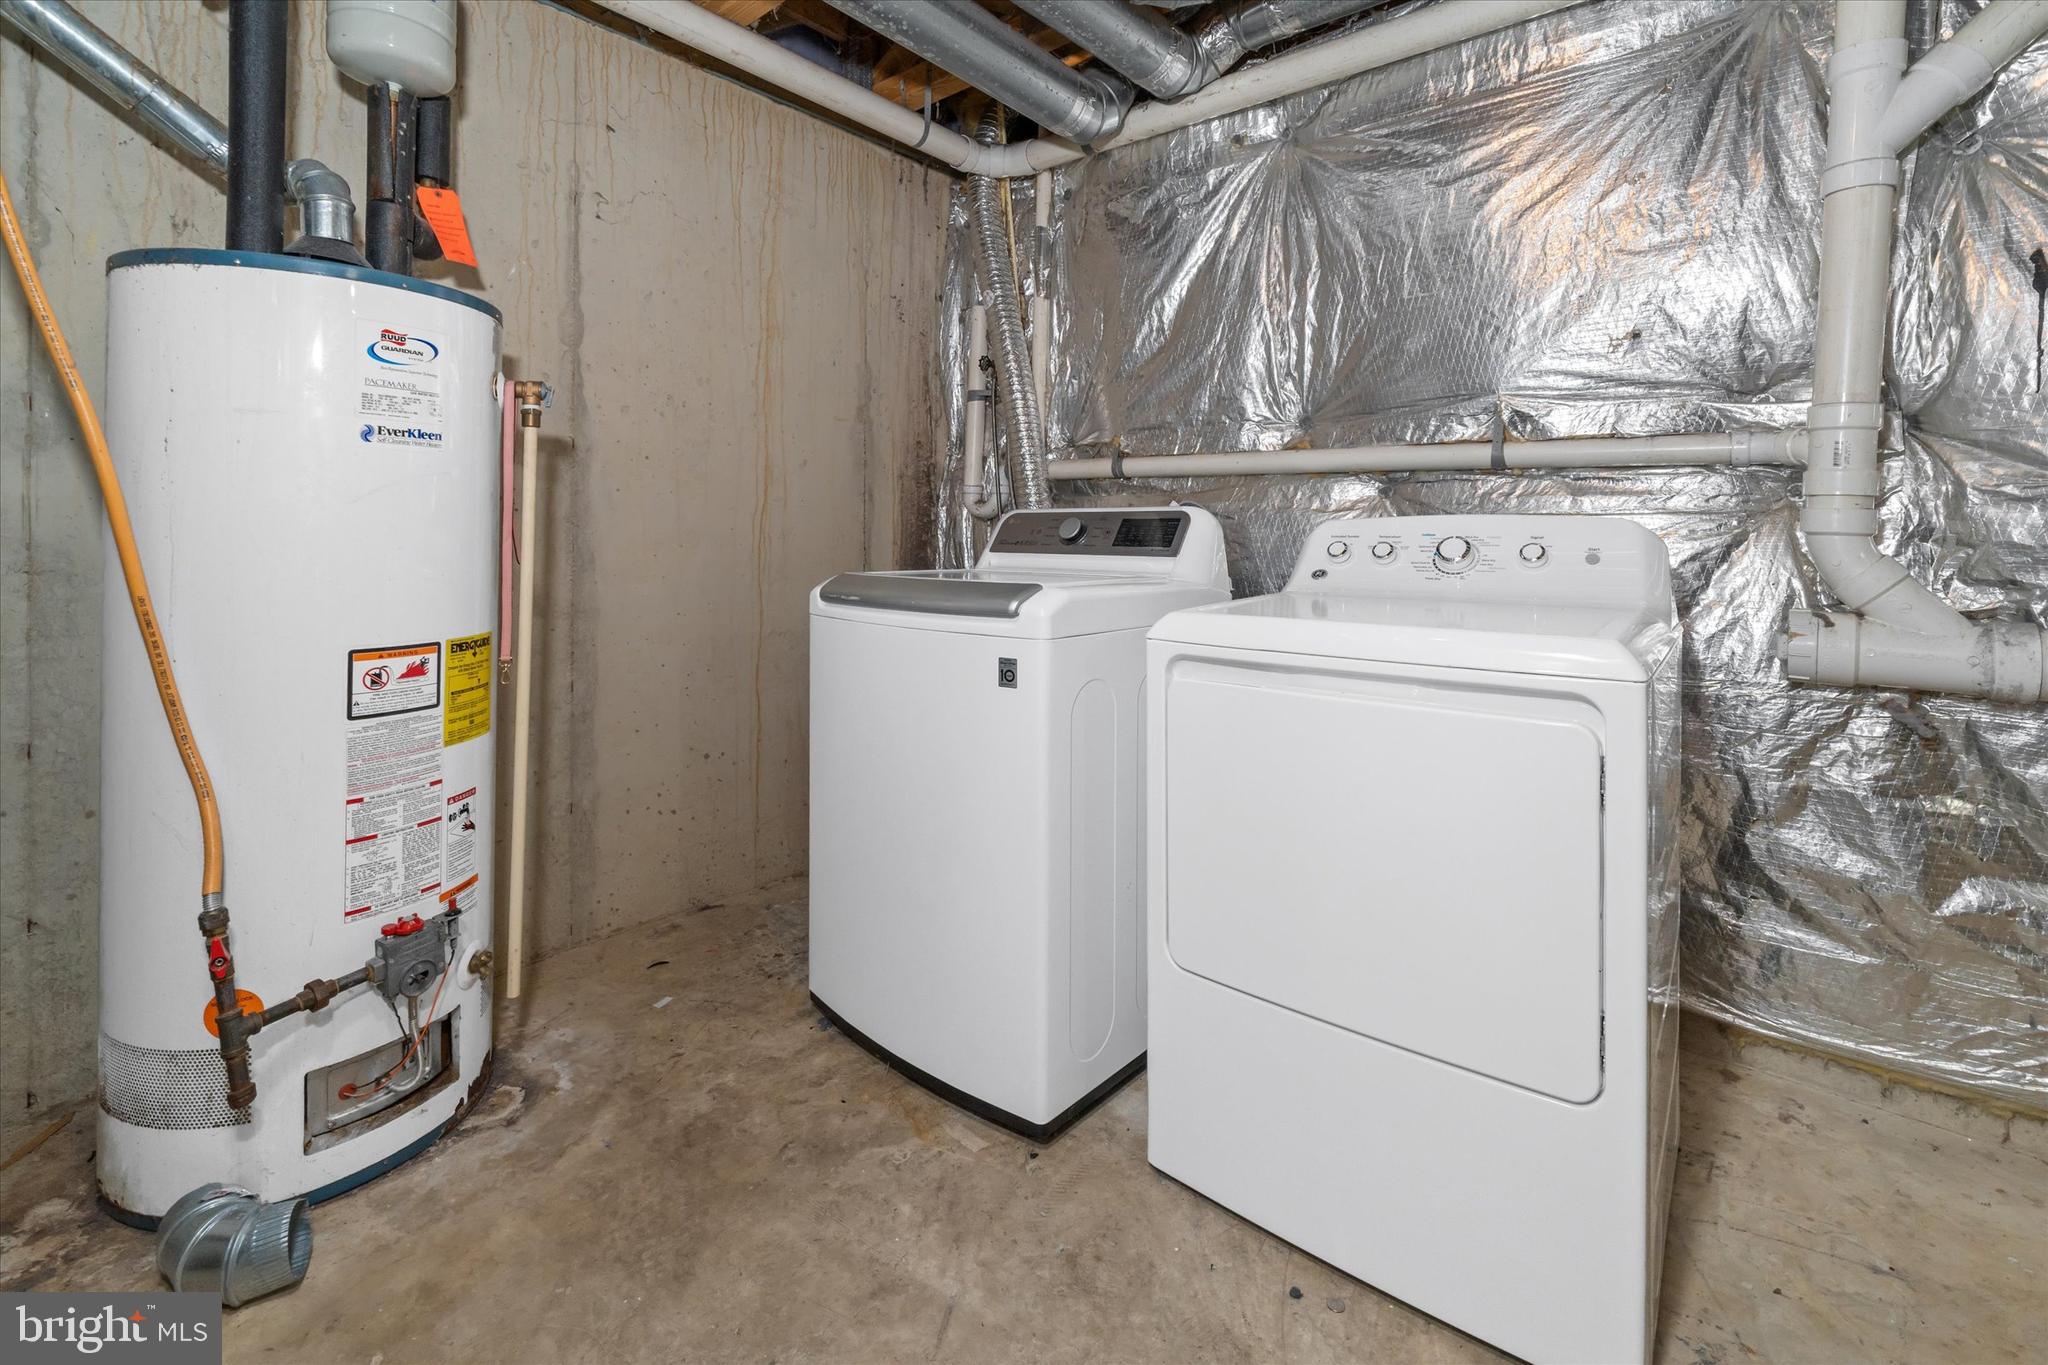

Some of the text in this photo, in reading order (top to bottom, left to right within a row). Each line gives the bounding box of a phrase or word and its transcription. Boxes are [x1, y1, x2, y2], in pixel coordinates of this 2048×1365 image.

[381, 333, 407, 343] RUUD
[381, 345, 424, 357] GUARDIAN
[364, 377, 418, 391] PACEMAKER
[377, 425, 443, 441] EverKleen
